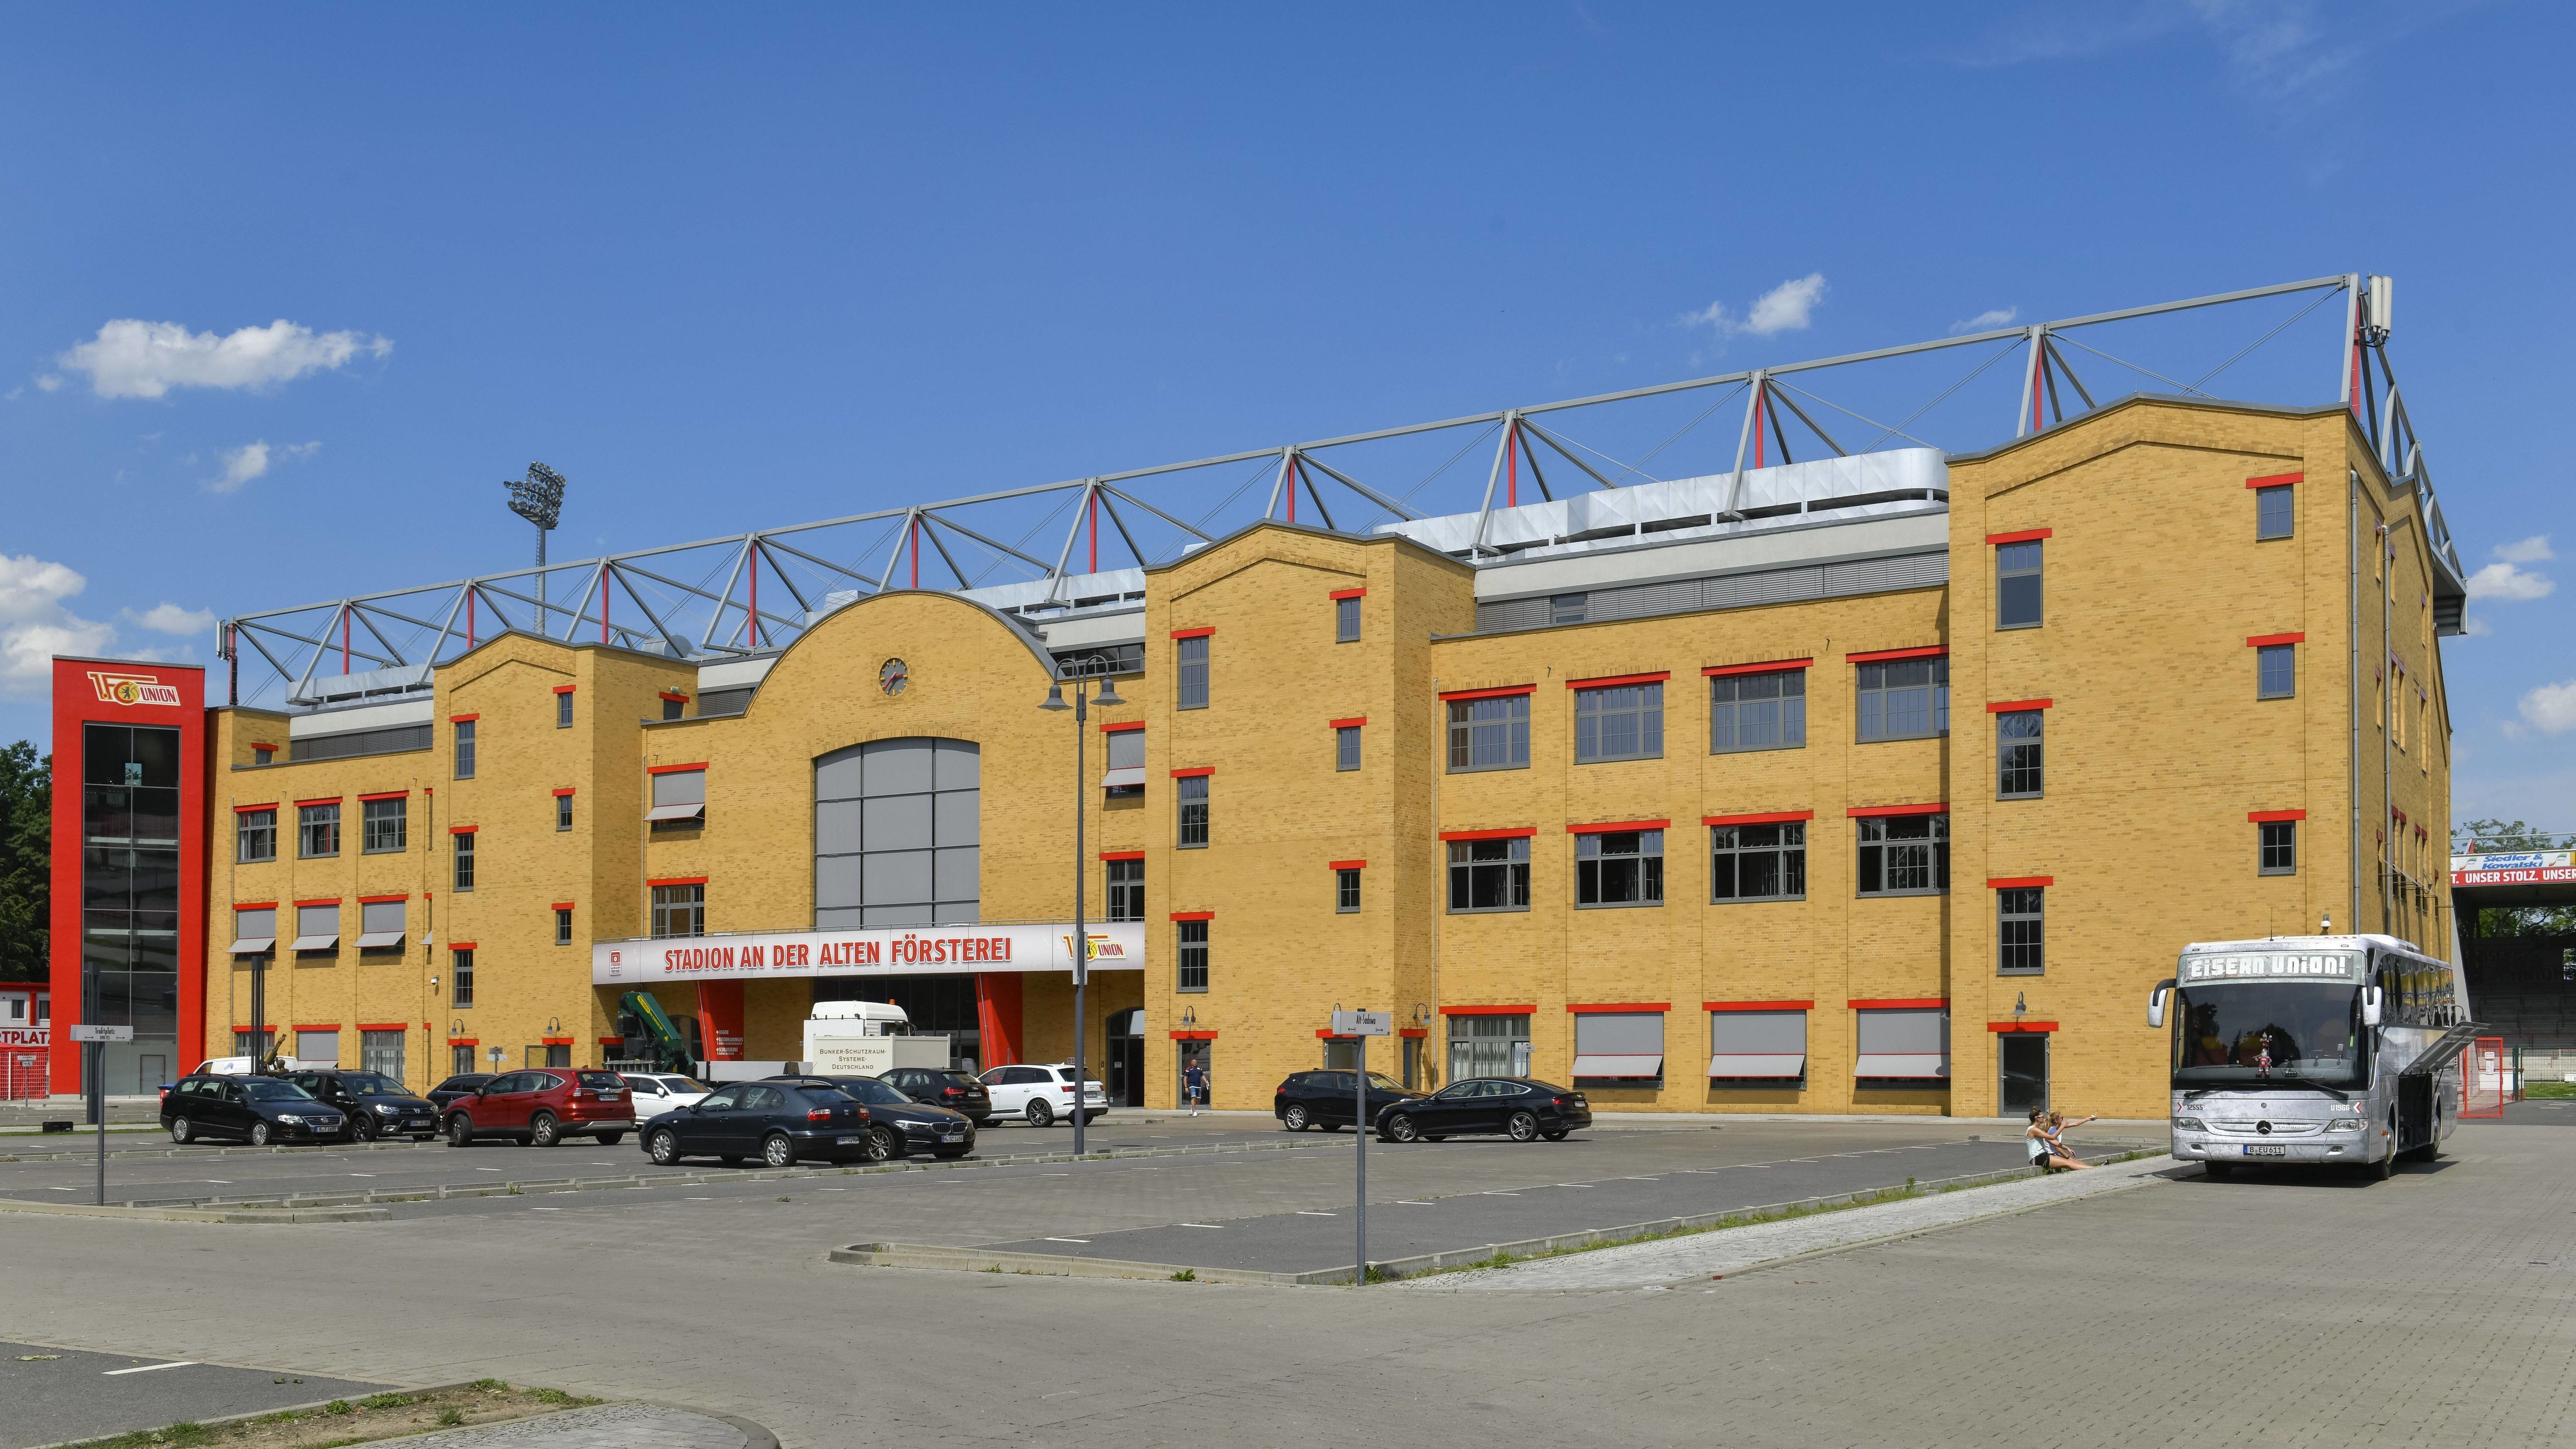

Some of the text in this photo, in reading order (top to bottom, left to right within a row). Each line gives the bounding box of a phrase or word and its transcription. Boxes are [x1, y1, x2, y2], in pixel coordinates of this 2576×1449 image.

[140, 687, 177, 703] UNION
[2482, 860, 2544, 870] Kowalski
[2465, 872, 2501, 883] UNSER
[2503, 871, 2539, 881] STOLZ.
[665, 933, 1011, 971] STADION AN DER ALTEN FÖRSTEREI
[1097, 944, 1124, 956] UNION
[1356, 1013, 1376, 1025] Alt-Sadowa
[95, 1027, 115, 1035] Traktplatz
[0, 1031, 50, 1044] TPLAT
